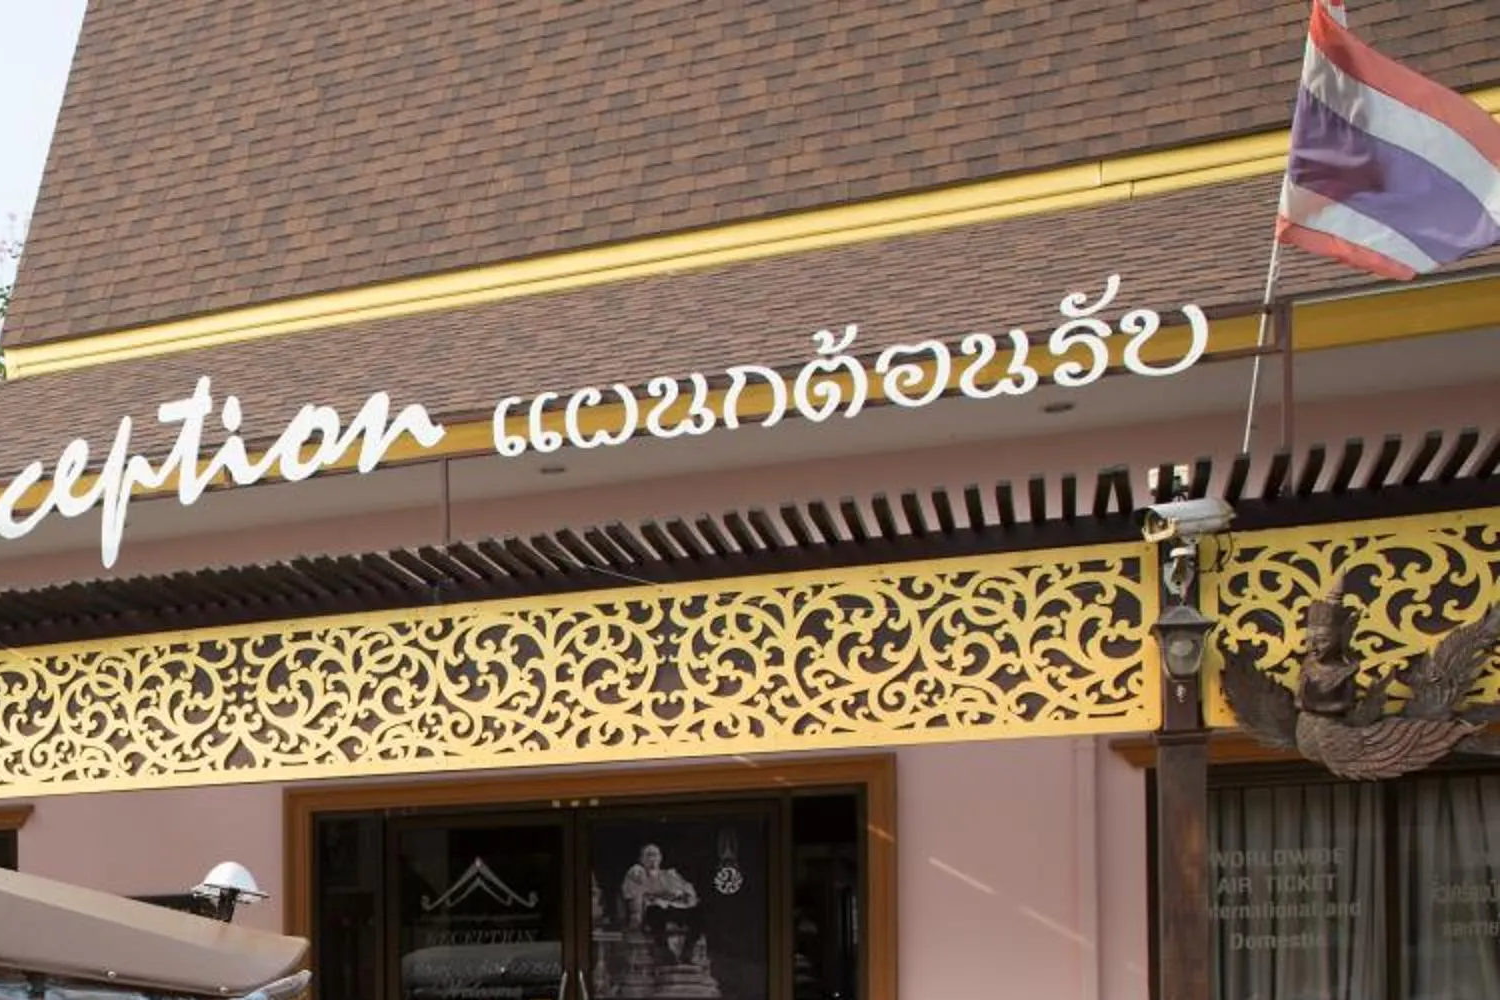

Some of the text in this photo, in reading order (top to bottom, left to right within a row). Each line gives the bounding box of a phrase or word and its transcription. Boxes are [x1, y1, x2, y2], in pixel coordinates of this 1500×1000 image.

[492, 275, 1208, 457] แผนกต้อนรับ
[1217, 873, 1337, 895] AIR TICKET
